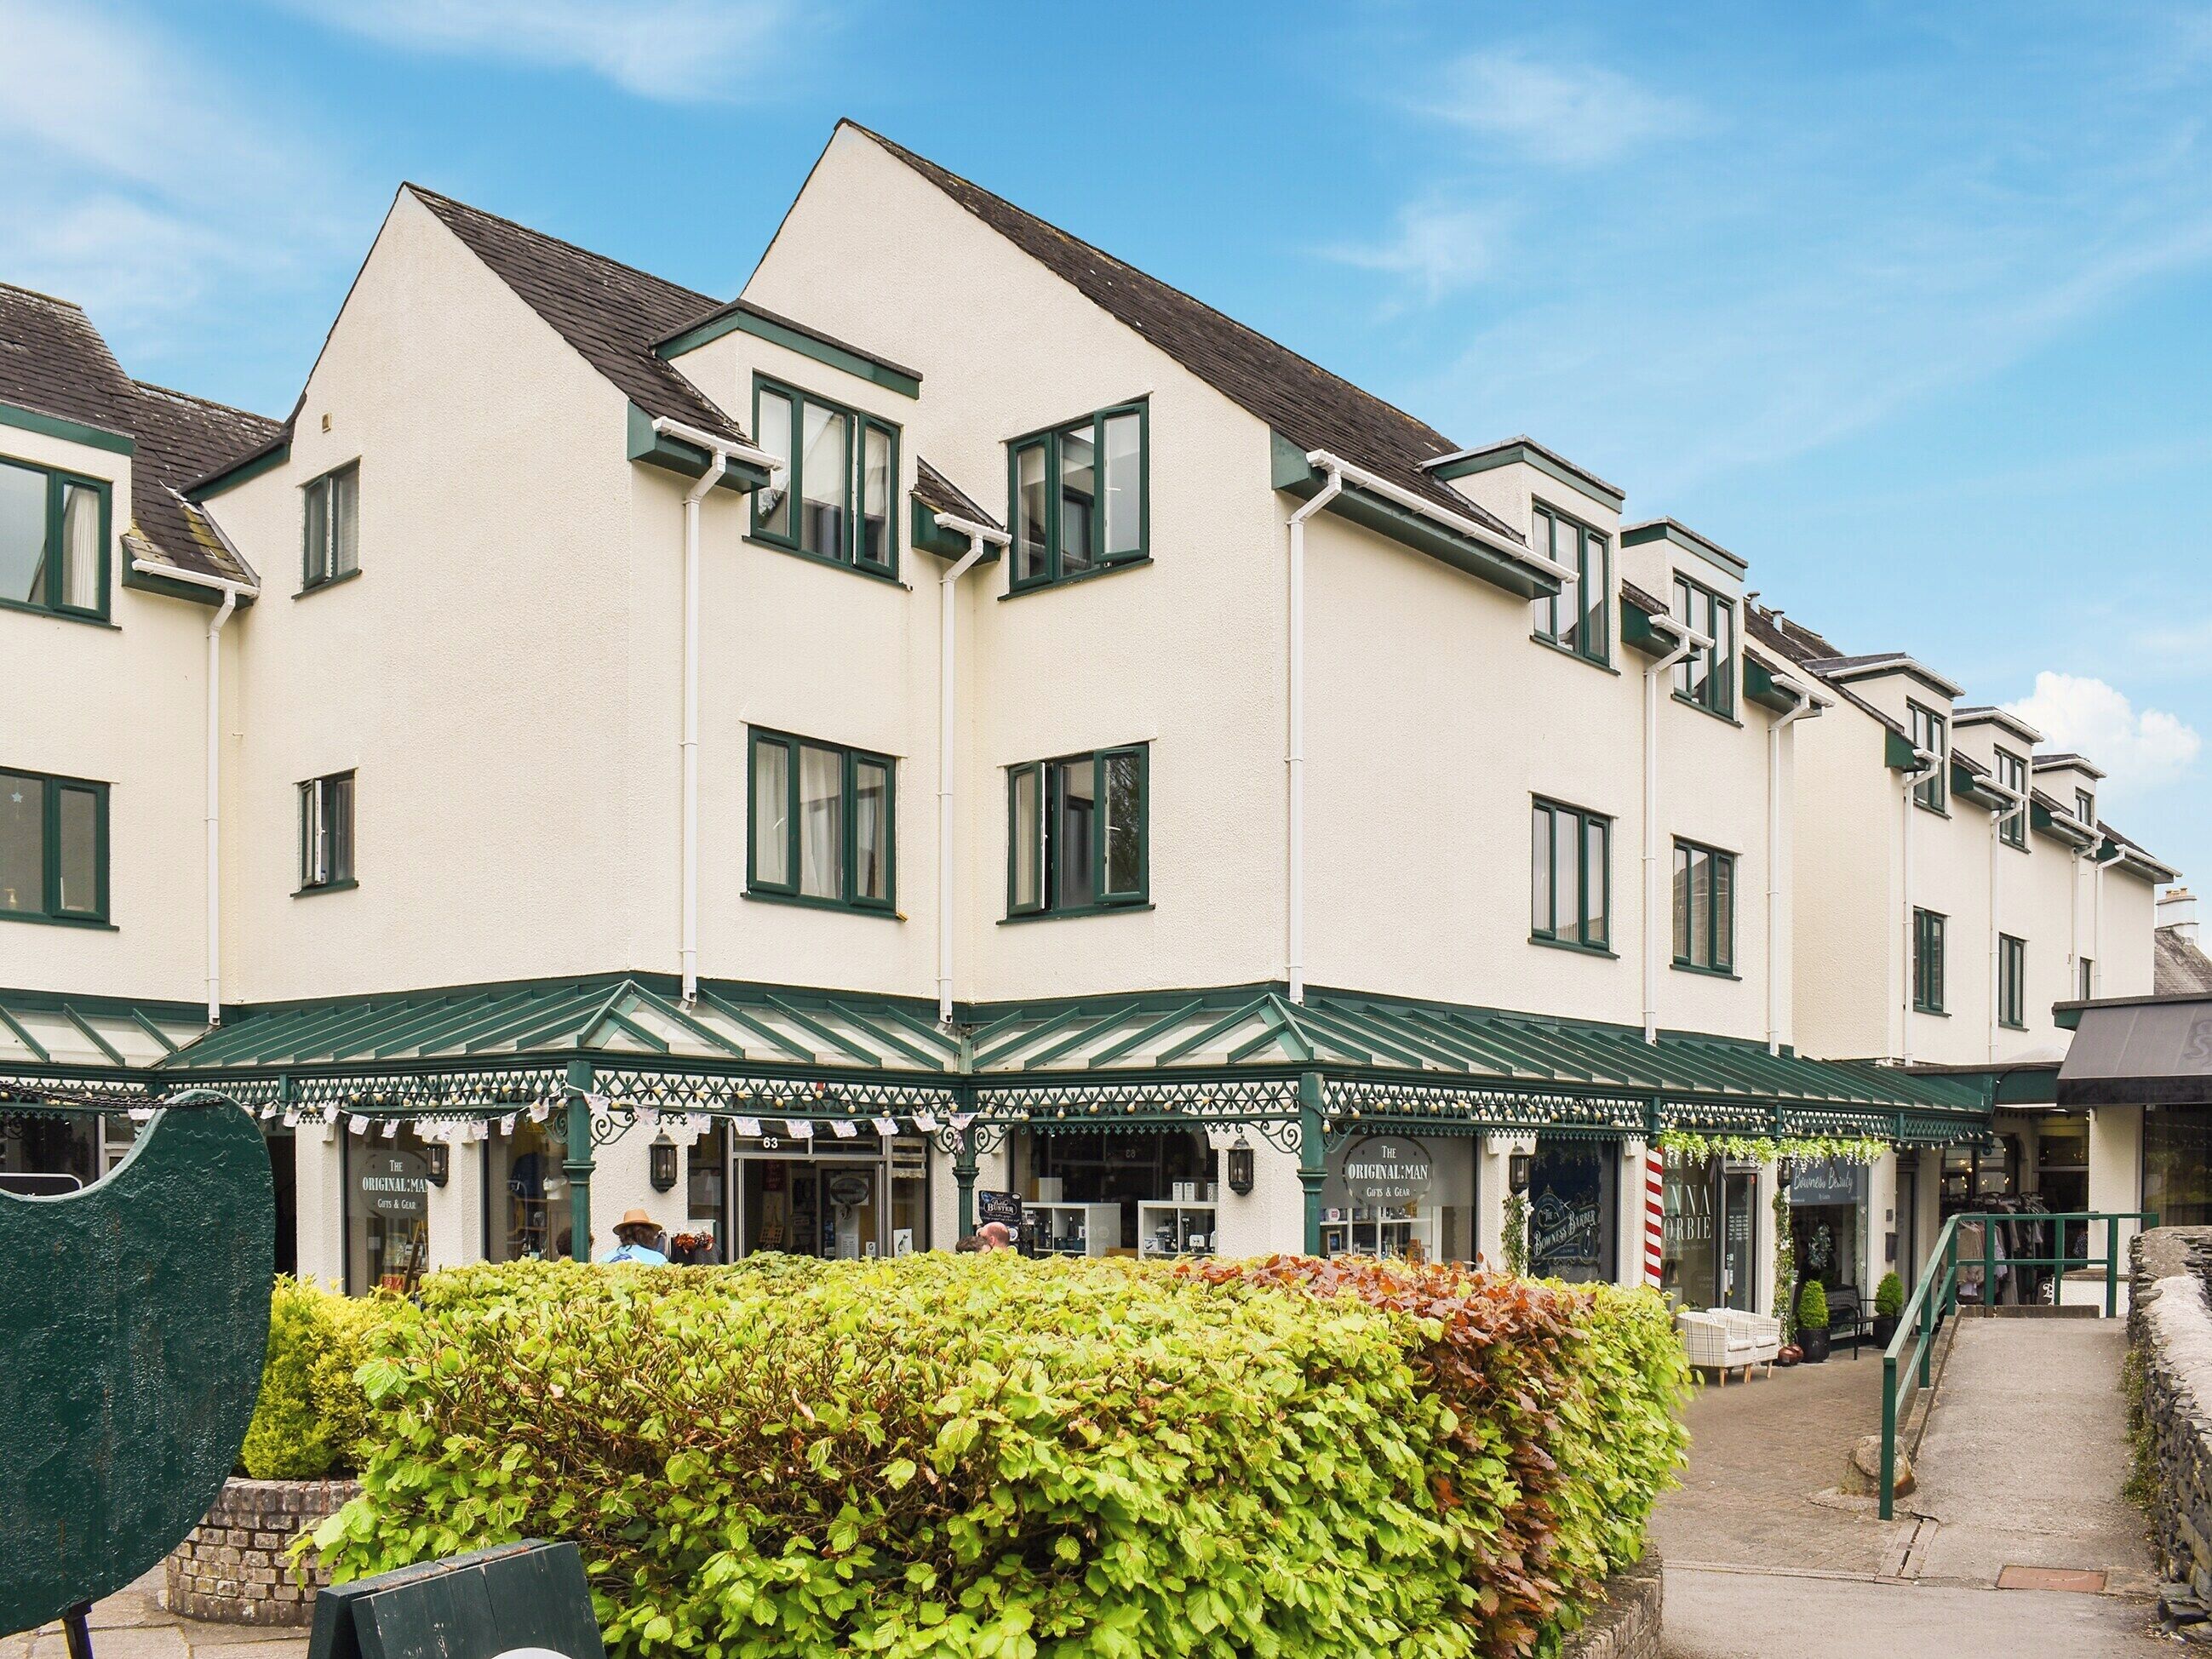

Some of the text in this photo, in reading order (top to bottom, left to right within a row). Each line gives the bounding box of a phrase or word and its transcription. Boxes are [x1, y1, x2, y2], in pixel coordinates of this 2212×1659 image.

[763, 1136, 778, 1149] 63
[1381, 1146, 1397, 1158] THE
[389, 1159, 403, 1172] THE
[1367, 1187, 1411, 1198] GIFTS & GEAR
[393, 1199, 399, 1209] &
[401, 1199, 416, 1210] GEAR
[988, 1203, 1014, 1214] BUSTER
[1664, 1216, 1711, 1242] ORBIE
